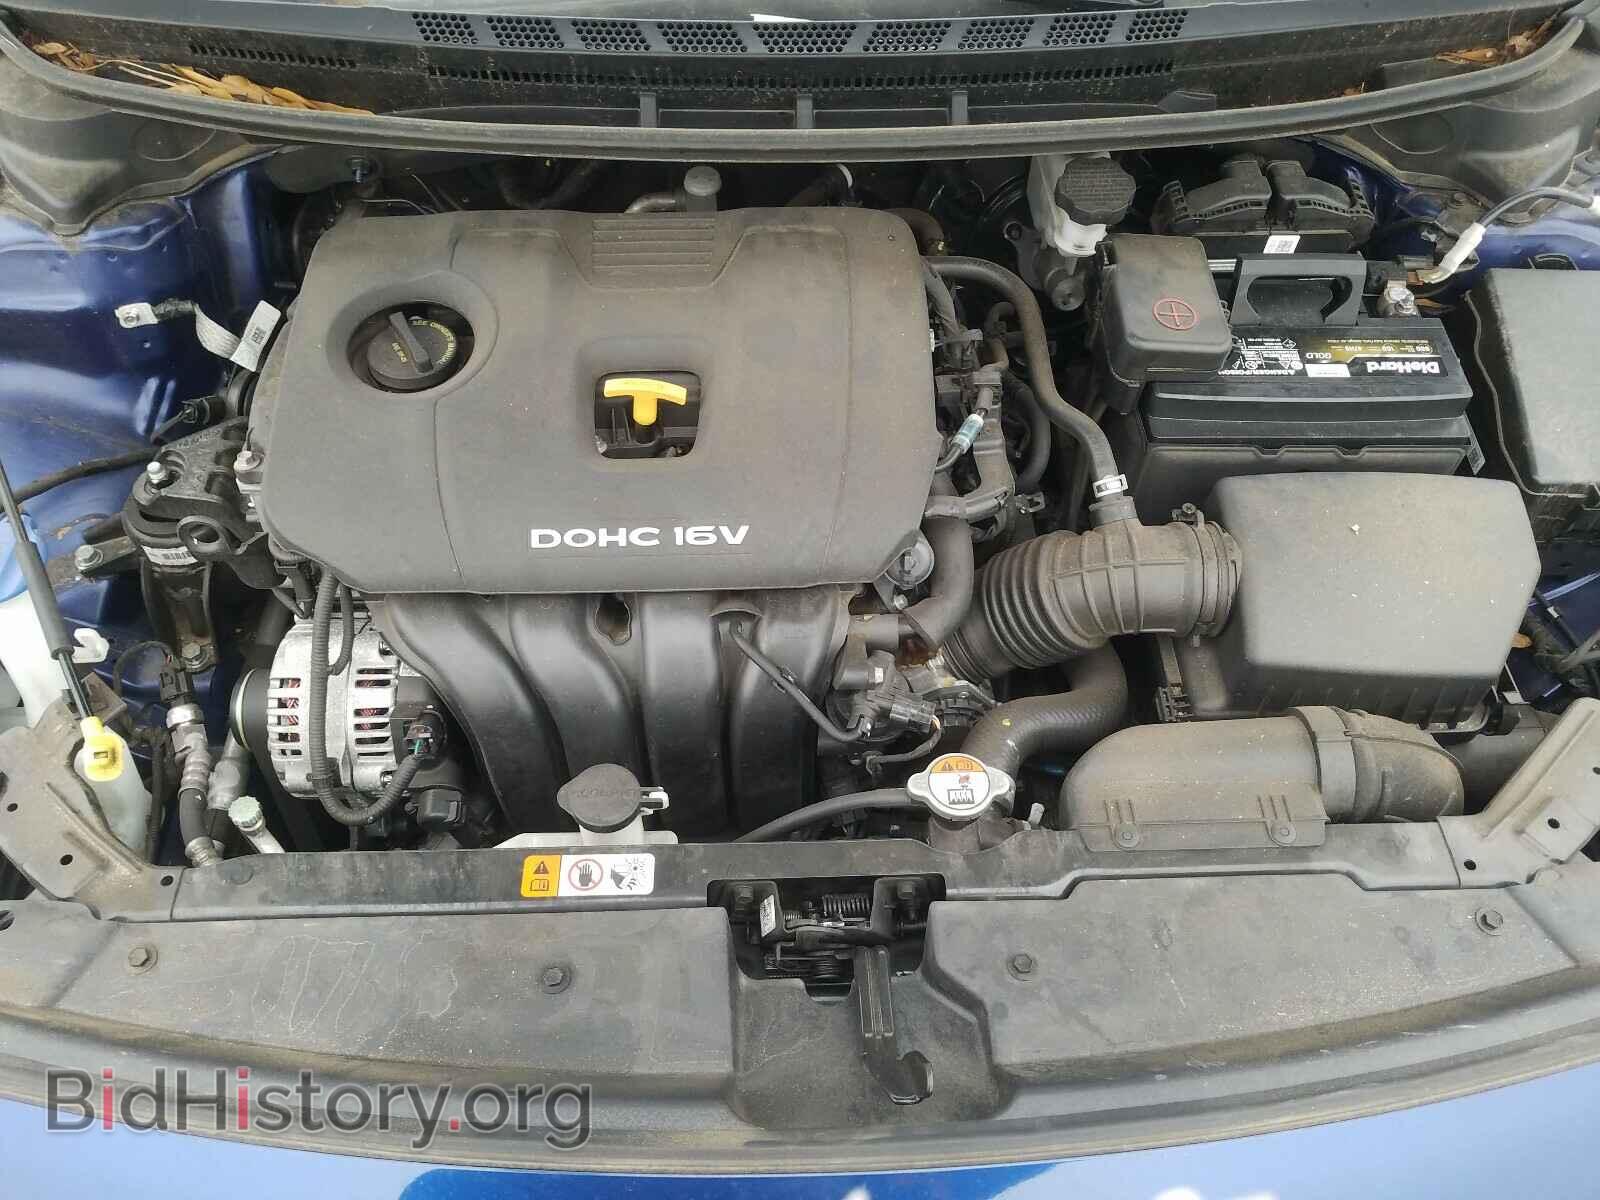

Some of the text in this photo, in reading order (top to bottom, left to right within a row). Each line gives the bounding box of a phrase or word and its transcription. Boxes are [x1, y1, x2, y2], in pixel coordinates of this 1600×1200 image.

[1366, 361, 1440, 374] DieHard
[530, 525, 749, 548] DOHC 16V
